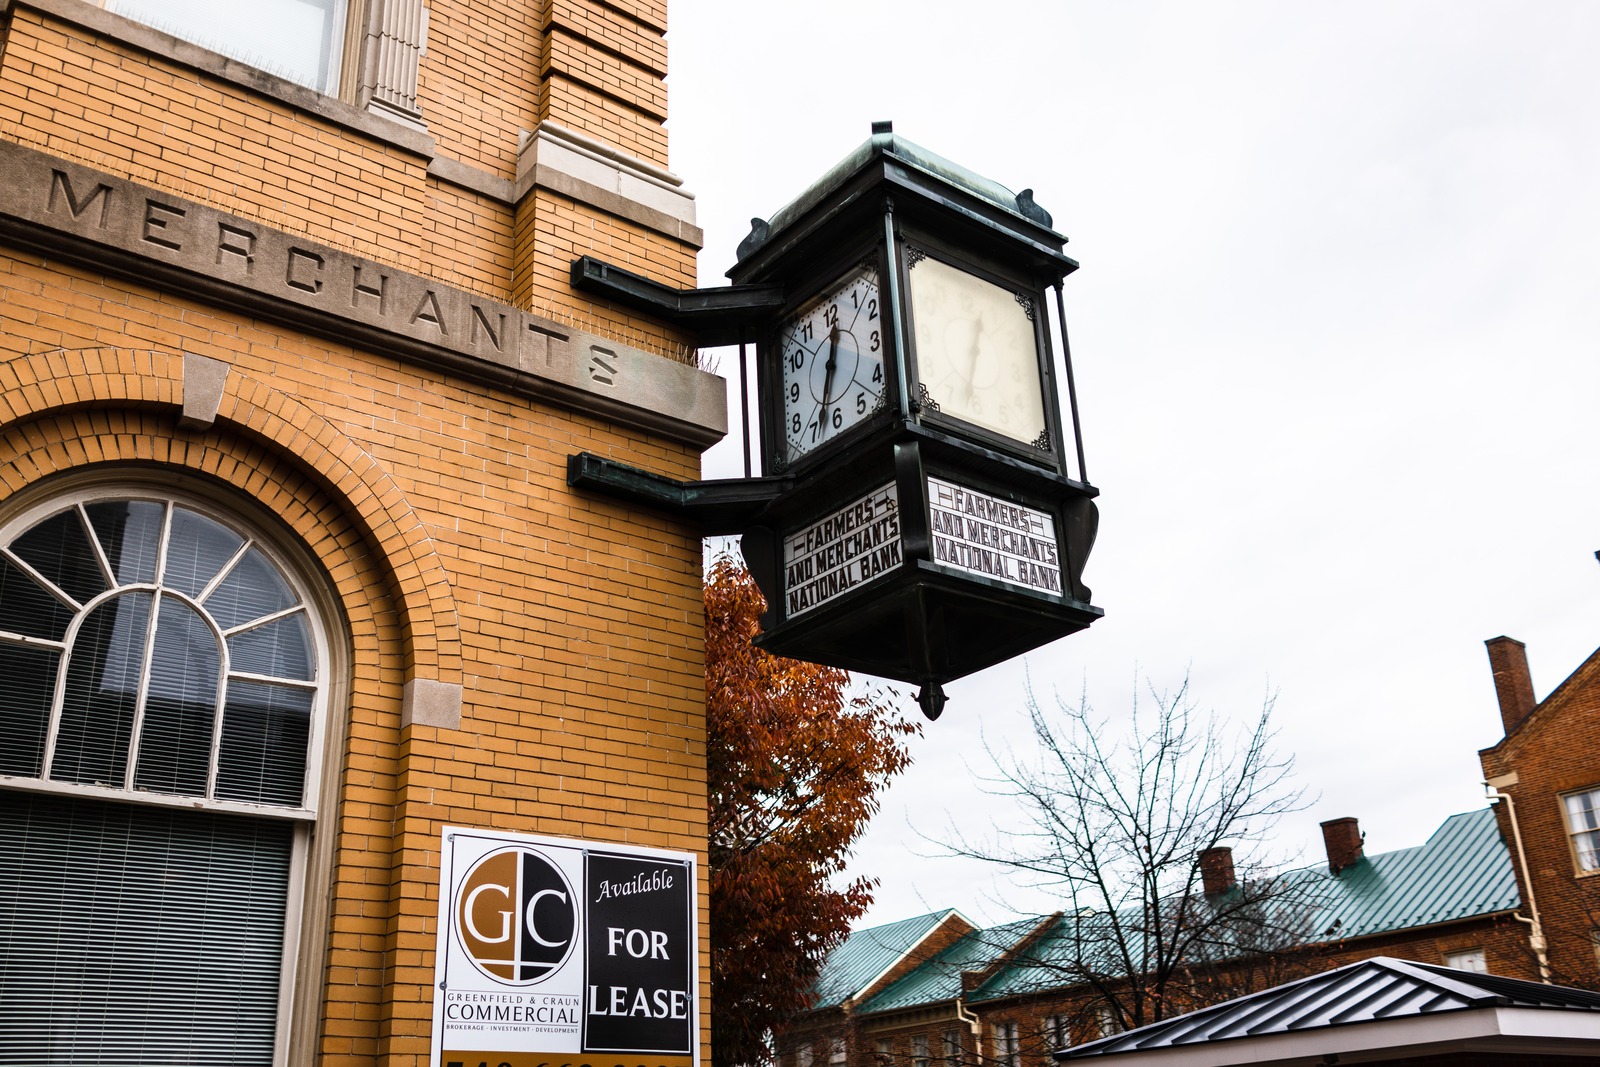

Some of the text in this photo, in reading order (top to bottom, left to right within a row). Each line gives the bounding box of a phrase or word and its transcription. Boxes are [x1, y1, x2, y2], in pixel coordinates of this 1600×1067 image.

[45, 168, 619, 386] MERCHANTS
[851, 290, 858, 309] 1
[868, 299, 878, 321] 2
[823, 304, 839, 328] 12
[801, 320, 814, 343] 11
[870, 330, 880, 352] 3
[789, 349, 804, 373] 10
[872, 363, 882, 384] 4
[791, 382, 800, 403] 9
[856, 392, 866, 415] 5
[792, 413, 801, 434] 8
[832, 407, 843, 429] 6
[809, 421, 818, 444] 7
[952, 488, 1030, 532] FARMERS
[806, 497, 875, 554] FARMERS
[933, 509, 1057, 565] AND MERCHANTS
[787, 512, 899, 588] AND MERCHANTS
[936, 536, 1060, 592] NATIONAL BANK
[789, 540, 902, 614] NATIONAL BANK
[595, 868, 673, 902] Available
[607, 926, 670, 960] FOR
[447, 993, 523, 1004] GREENFIELD
[543, 997, 579, 1006] CRAUN
[588, 985, 687, 1020] LEASE
[447, 1003, 579, 1024] COMMERCIAL
